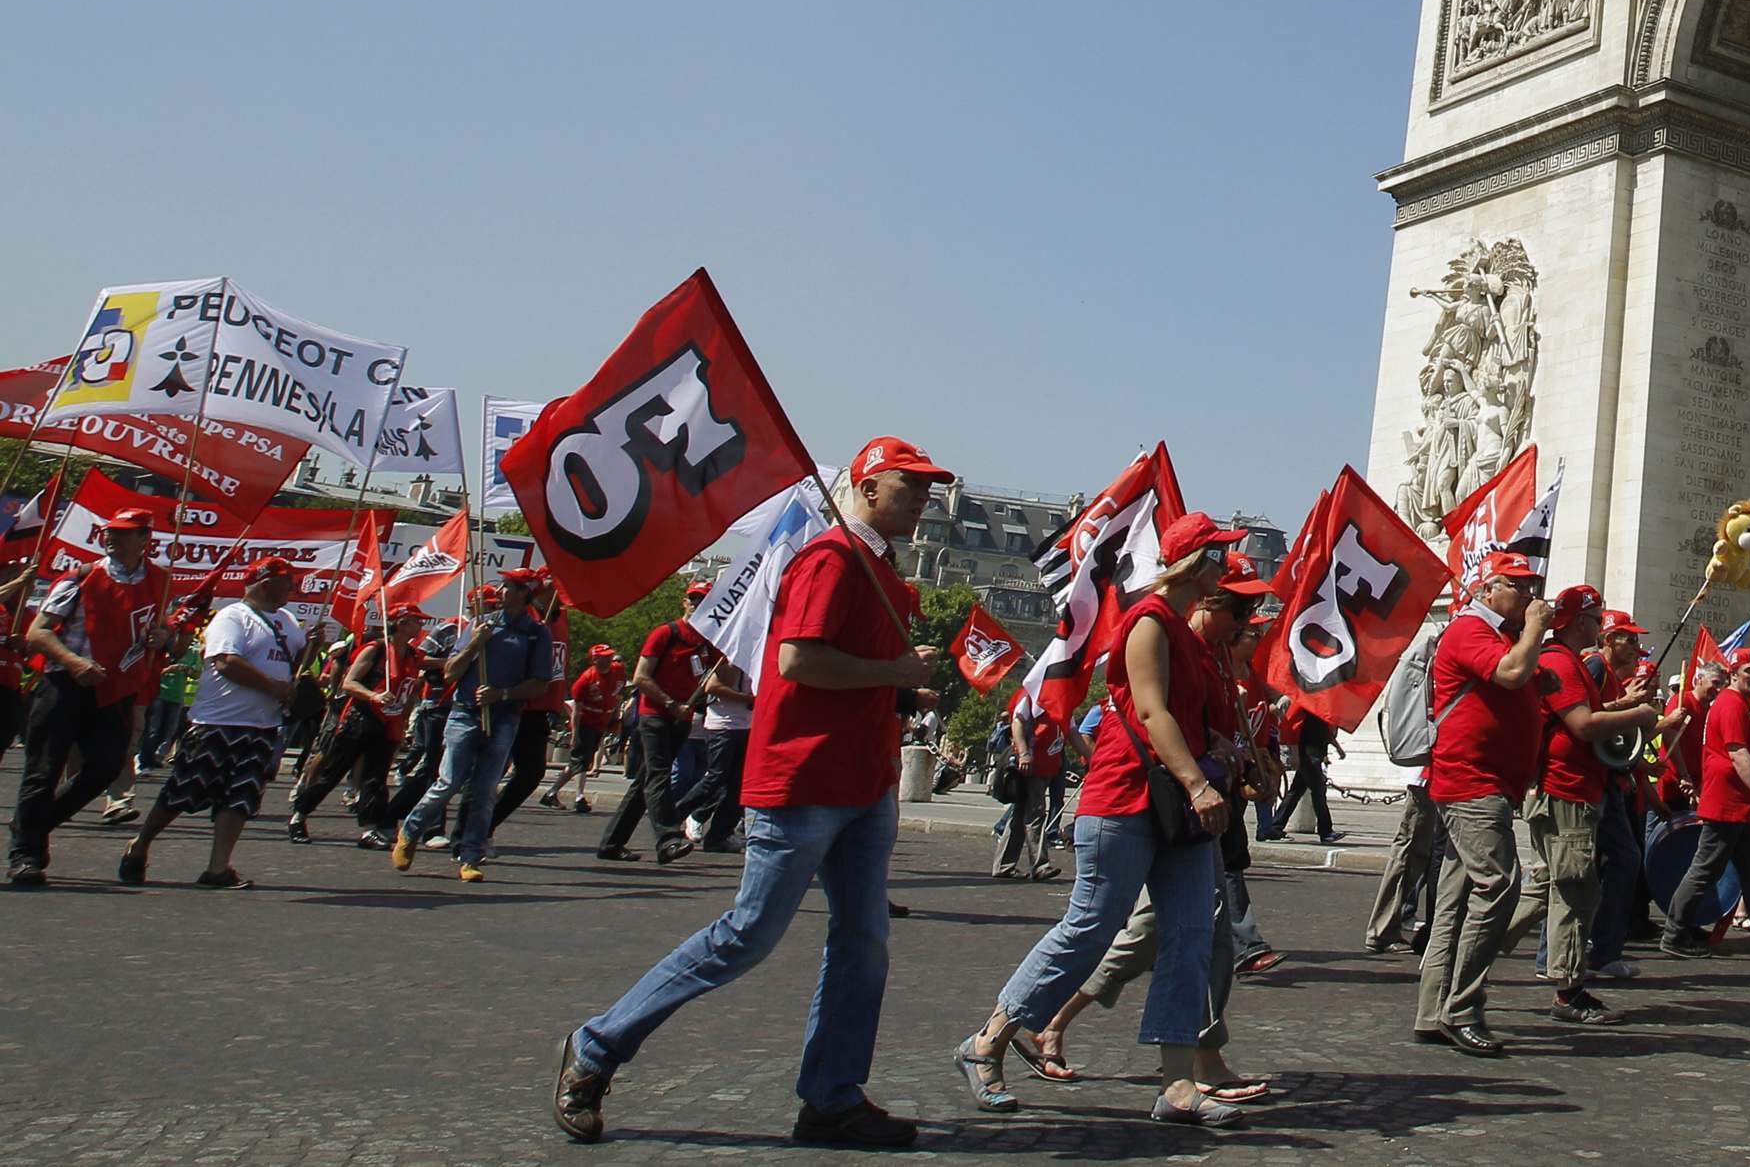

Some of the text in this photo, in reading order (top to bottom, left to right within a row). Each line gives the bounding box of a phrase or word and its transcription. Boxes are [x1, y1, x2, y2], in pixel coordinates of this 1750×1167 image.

[167, 293, 354, 375] PEUGEOT
[238, 430, 284, 462] PSA
[1674, 456, 1694, 470] SAN
